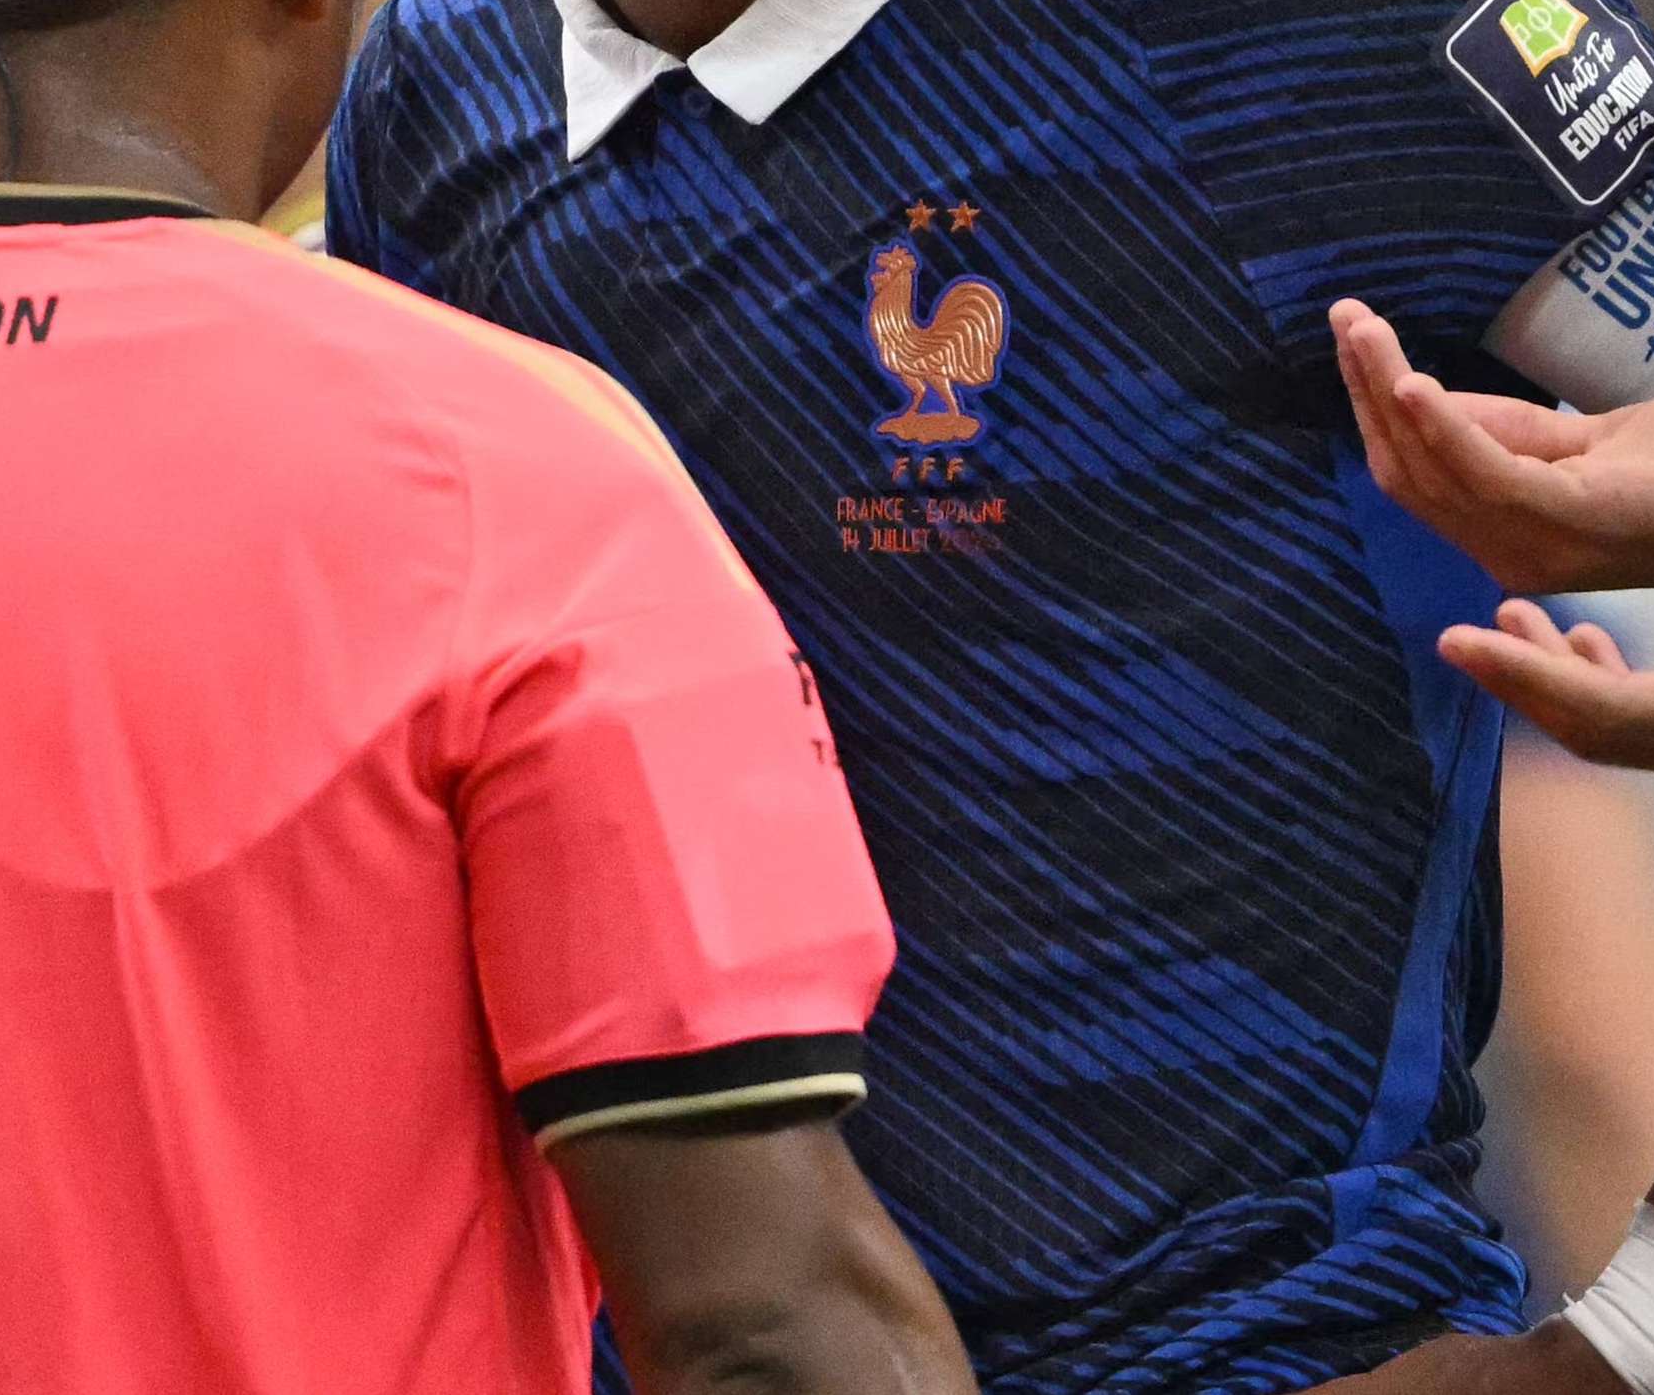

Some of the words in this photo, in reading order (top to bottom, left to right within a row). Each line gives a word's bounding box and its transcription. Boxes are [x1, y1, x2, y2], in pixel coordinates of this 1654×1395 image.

[1544, 55, 1599, 116] Unite
[1586, 30, 1616, 73] For
[1558, 55, 1653, 162] EDUCATION
[836, 496, 904, 522] FRANCE
[926, 497, 1007, 524] ESPAGNE
